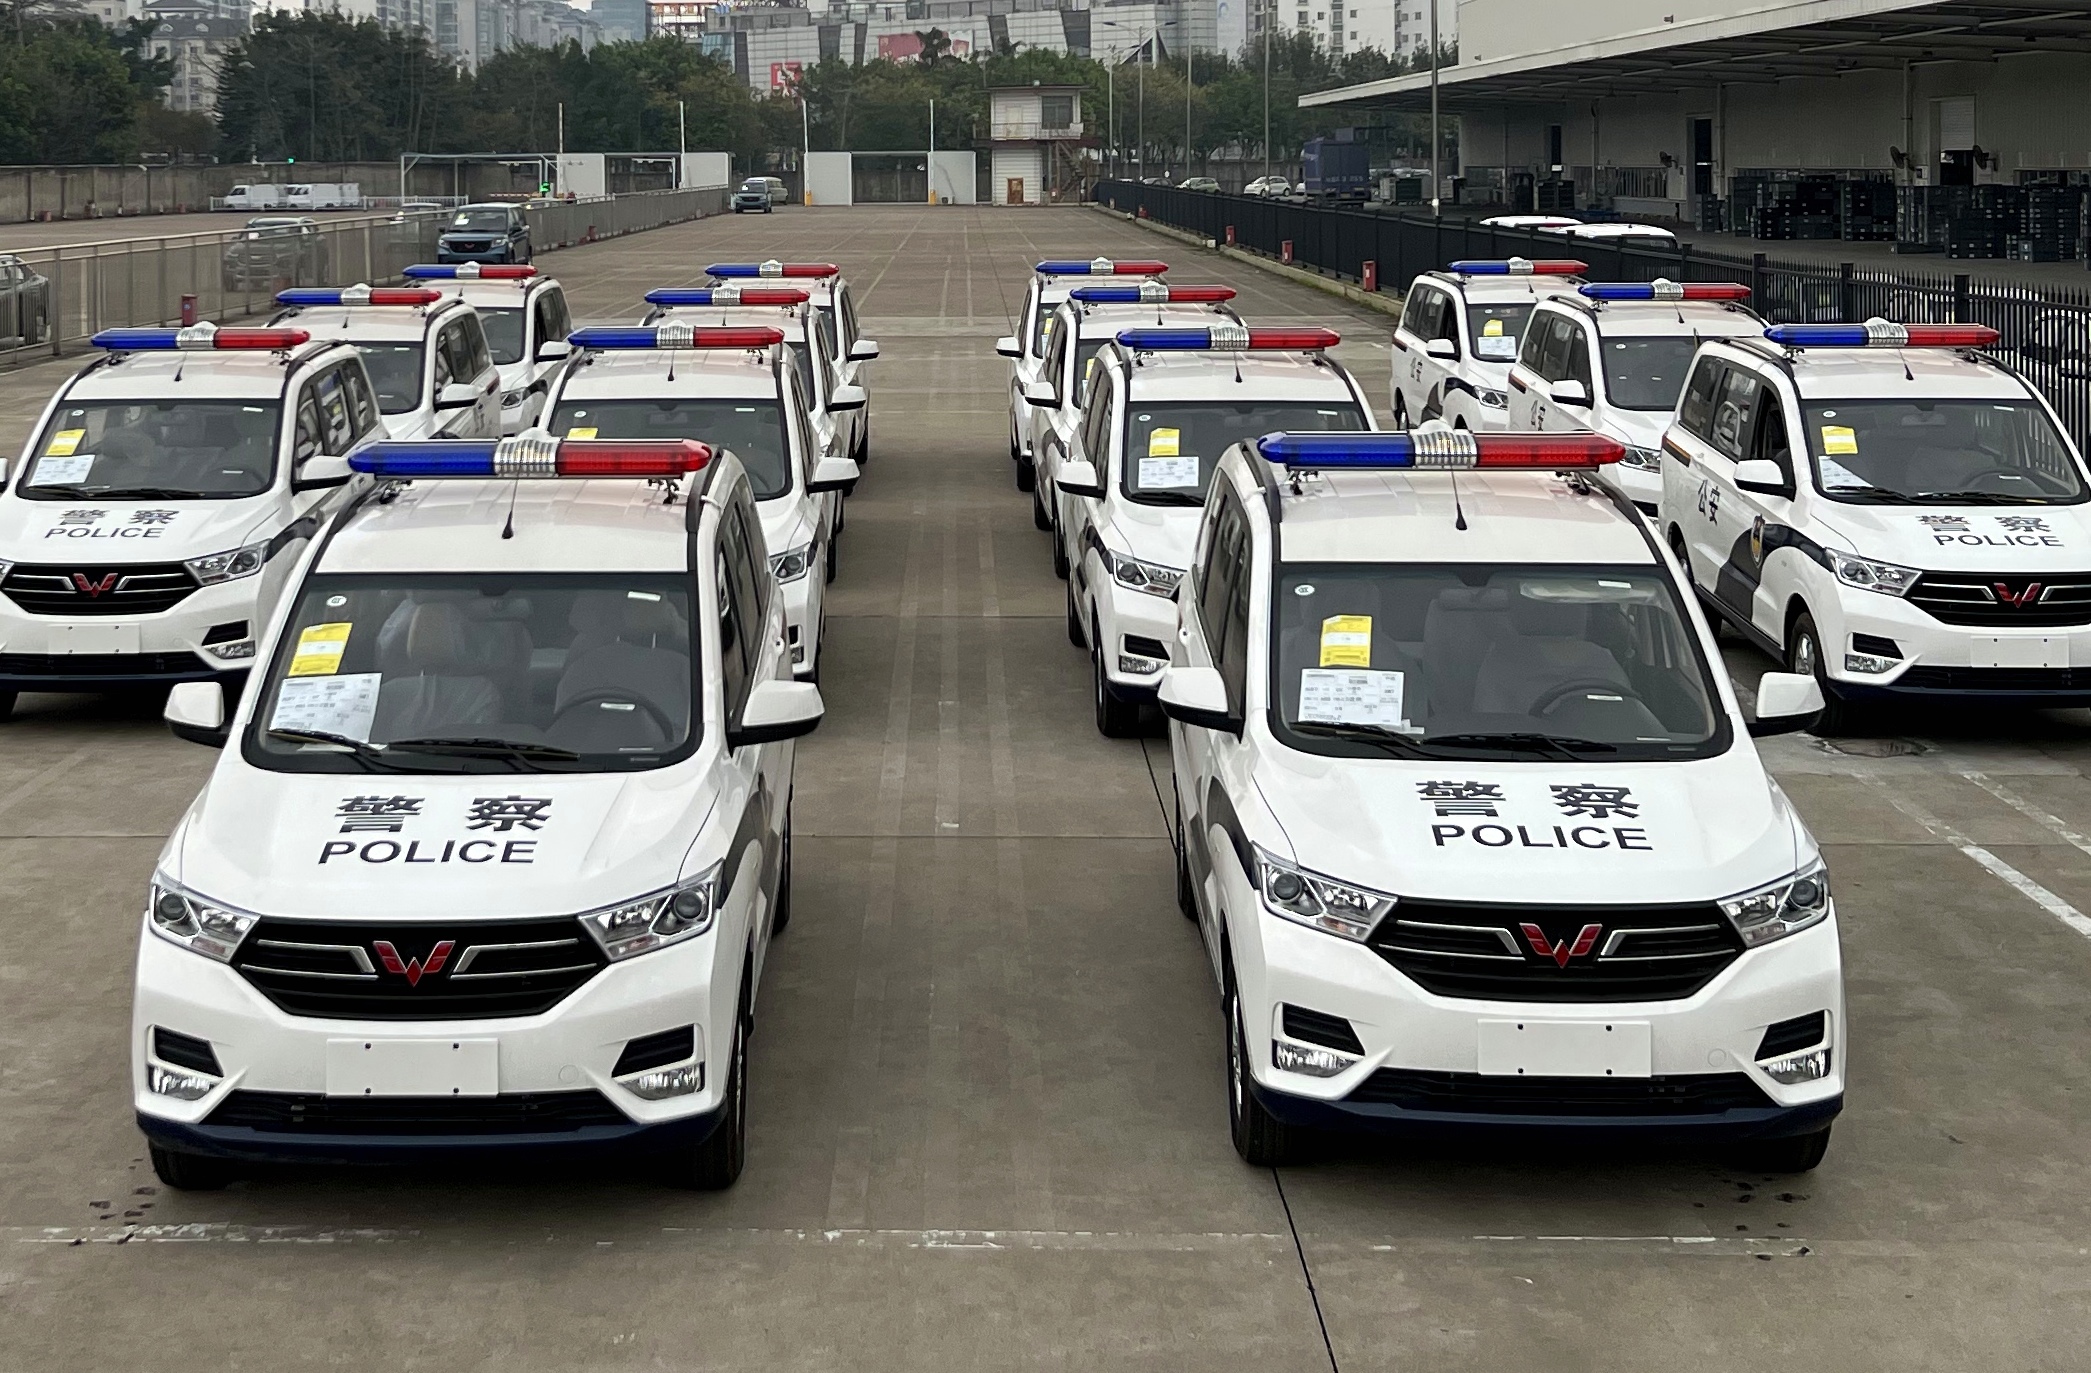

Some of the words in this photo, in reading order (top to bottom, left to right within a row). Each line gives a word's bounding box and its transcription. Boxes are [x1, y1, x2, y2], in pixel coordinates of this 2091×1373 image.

[1697, 479, 1721, 527] 公安
[59, 509, 180, 526] 警察
[1916, 515, 2052, 533] 警察
[44, 527, 166, 539] POLICE
[1933, 534, 2065, 547] POLICE
[1416, 780, 1640, 819] 警察
[335, 795, 553, 834] 警察
[1432, 824, 1653, 851] POLICE
[318, 840, 538, 865] POLICE
